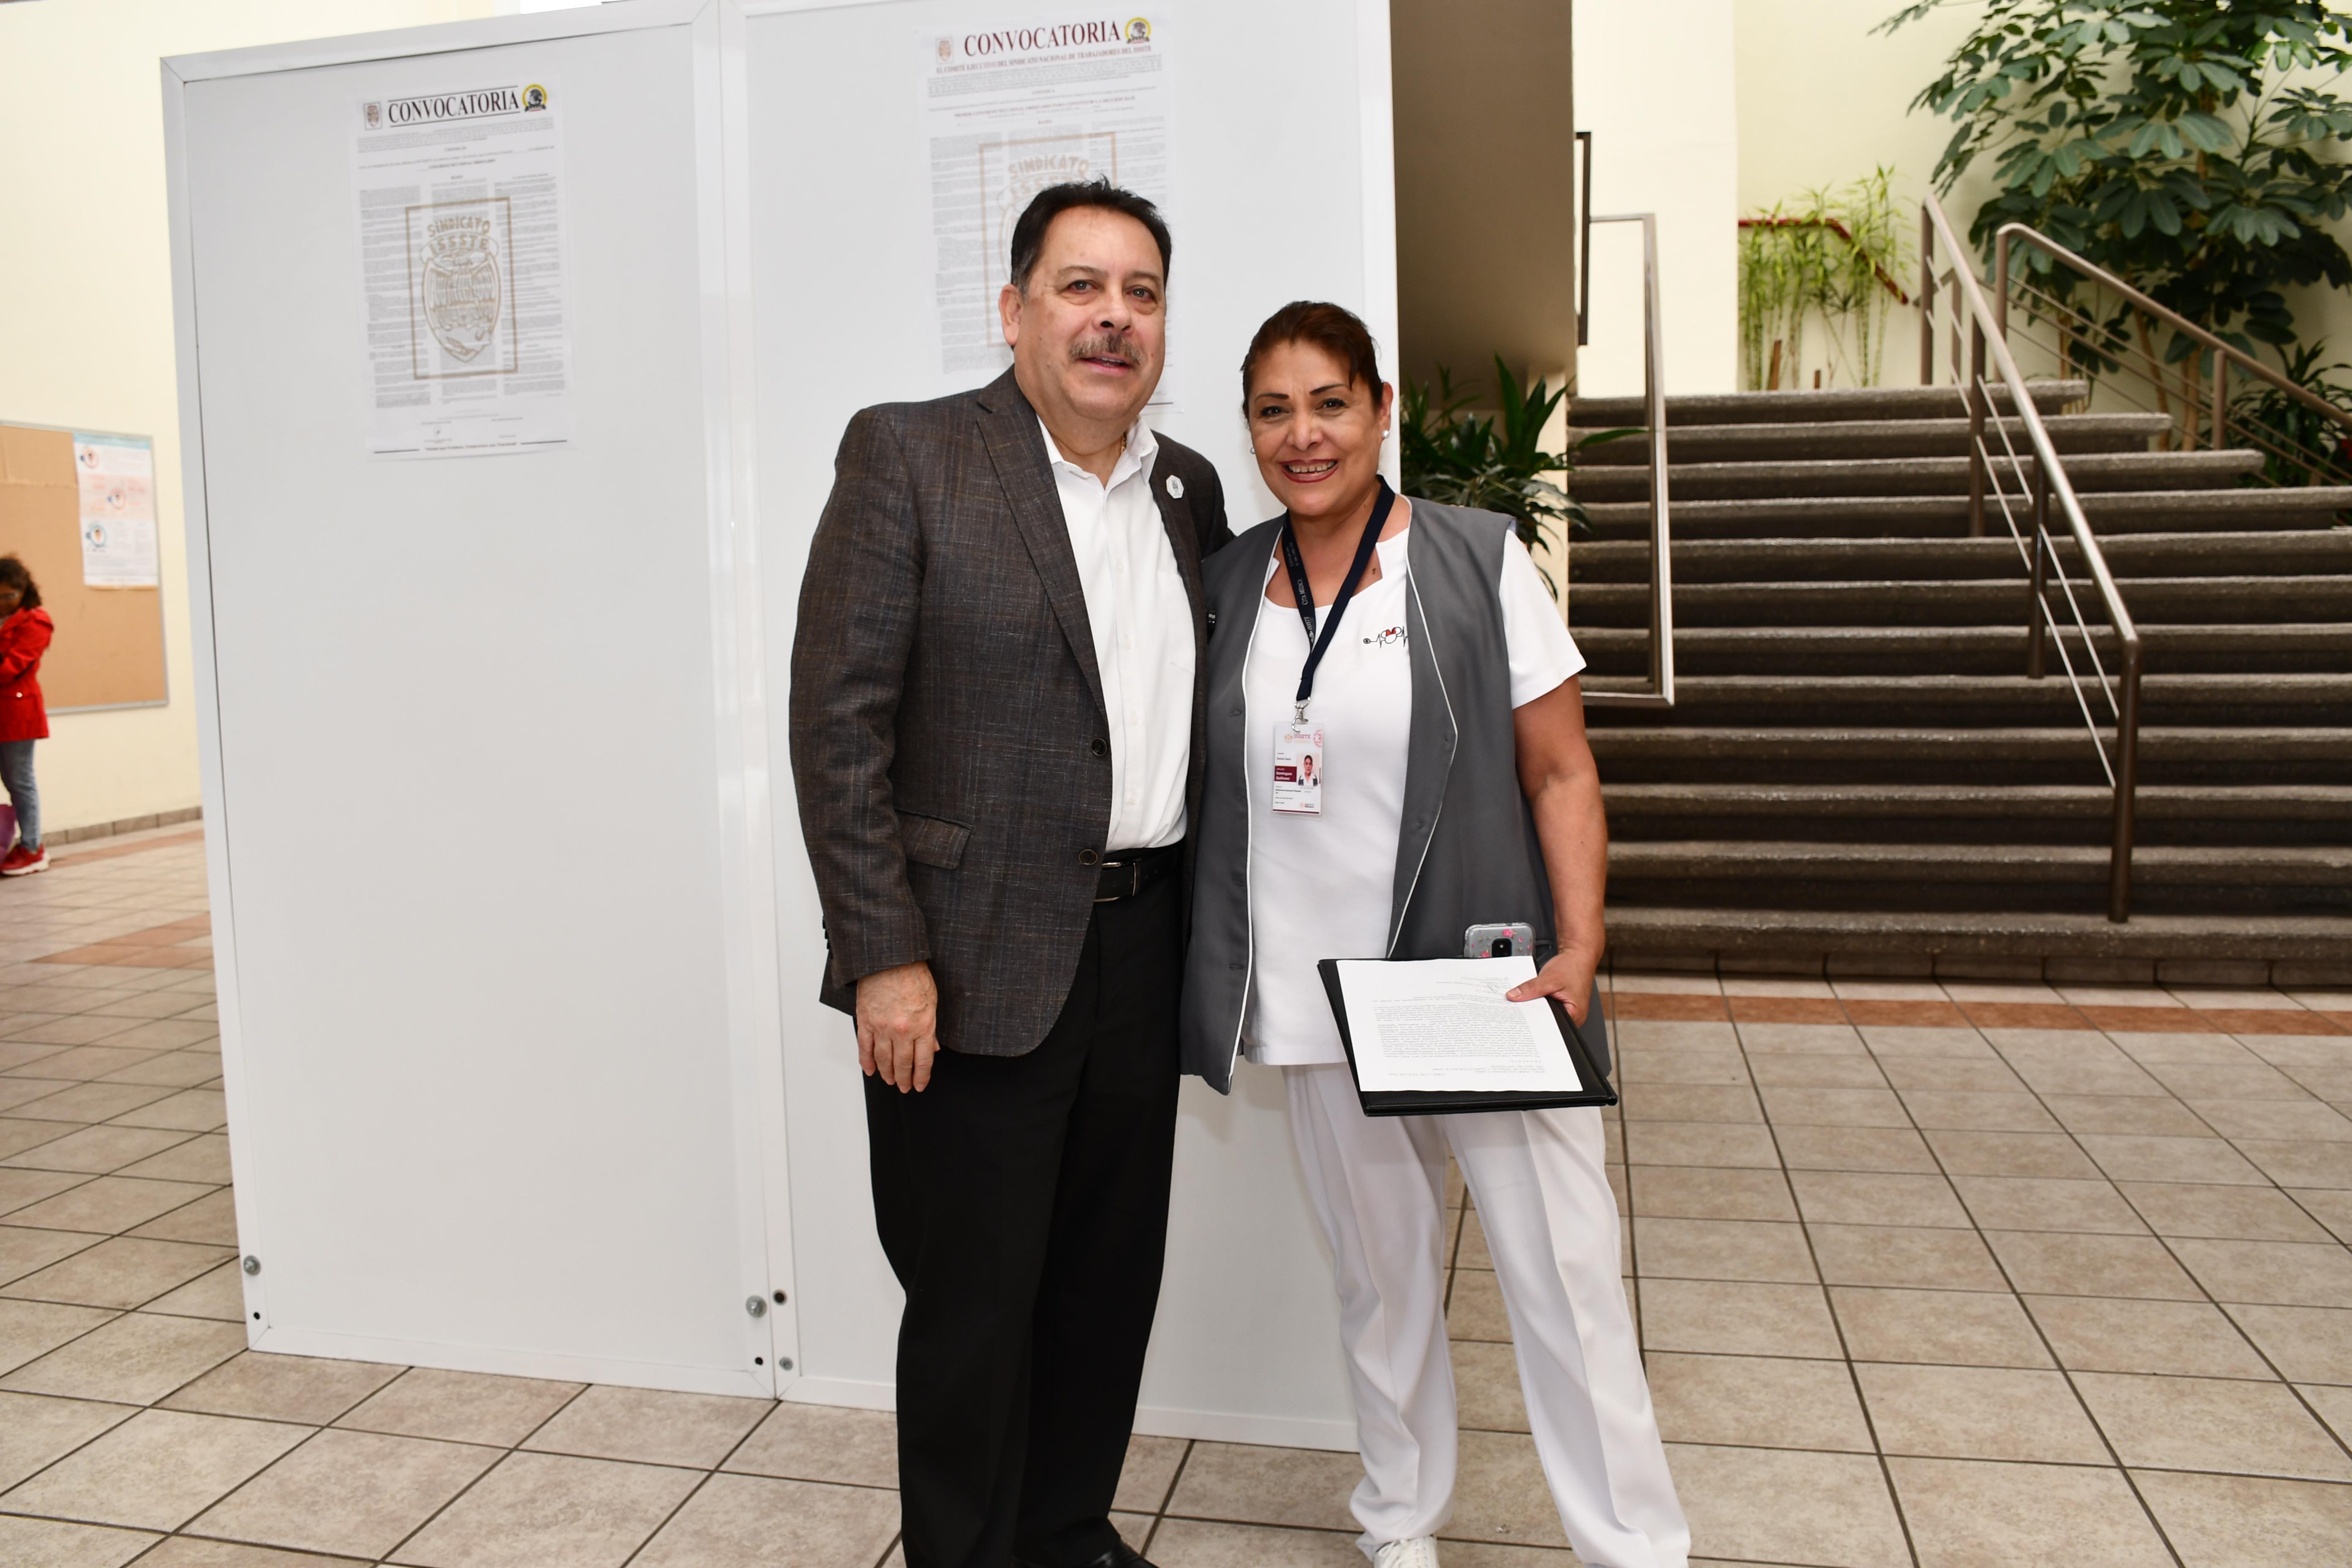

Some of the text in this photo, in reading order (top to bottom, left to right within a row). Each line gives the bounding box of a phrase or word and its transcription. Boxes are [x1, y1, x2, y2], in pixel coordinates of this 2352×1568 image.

[964, 21, 1121, 57] CONVOCATORIA
[388, 91, 520, 123] CONVOCATORIA
[1008, 155, 1089, 177] SINDICATO
[427, 216, 490, 238] SINDICATO
[429, 234, 488, 256] ISSSTE
